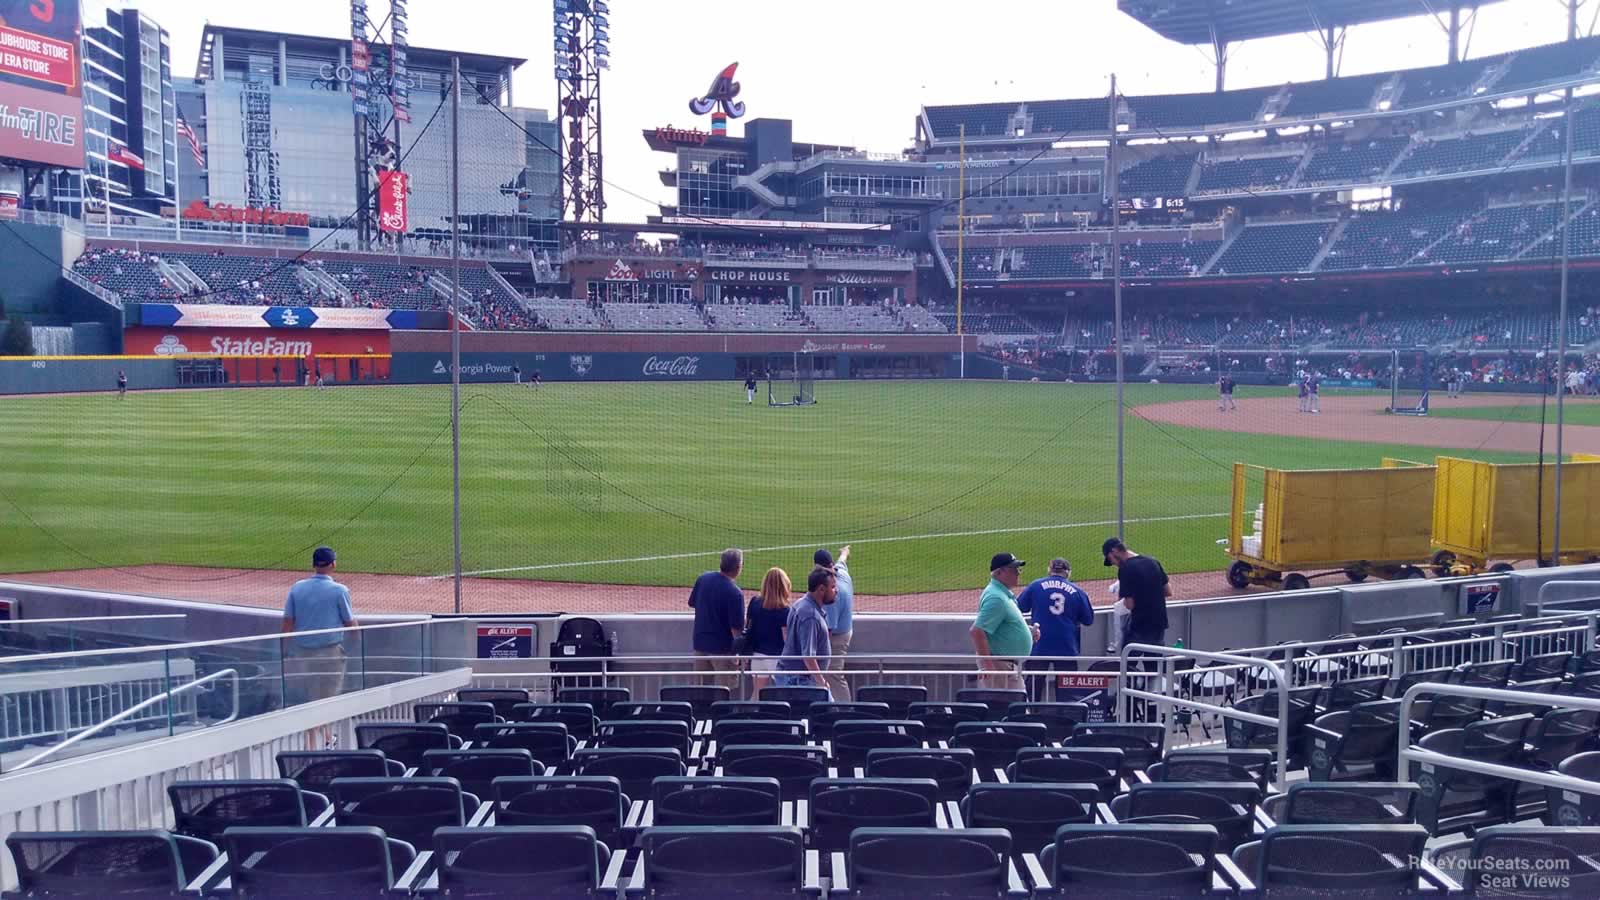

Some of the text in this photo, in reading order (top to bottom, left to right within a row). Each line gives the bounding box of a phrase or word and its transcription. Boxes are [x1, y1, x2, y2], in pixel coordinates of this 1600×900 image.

[42, 43, 69, 61] STORE
[5, 53, 21, 69] ERA
[23, 57, 50, 75] STORE
[18, 107, 76, 146] TIRE
[1166, 199, 1184, 207] 6:15
[645, 270, 676, 279] LIGHT
[711, 271, 790, 281] CHOP HOUSE
[32, 360, 46, 369] 400
[485, 363, 512, 373] Power
[1041, 580, 1077, 595] MURPHY
[1048, 592, 1066, 616] 3
[1062, 677, 1104, 686] BE ALERT
